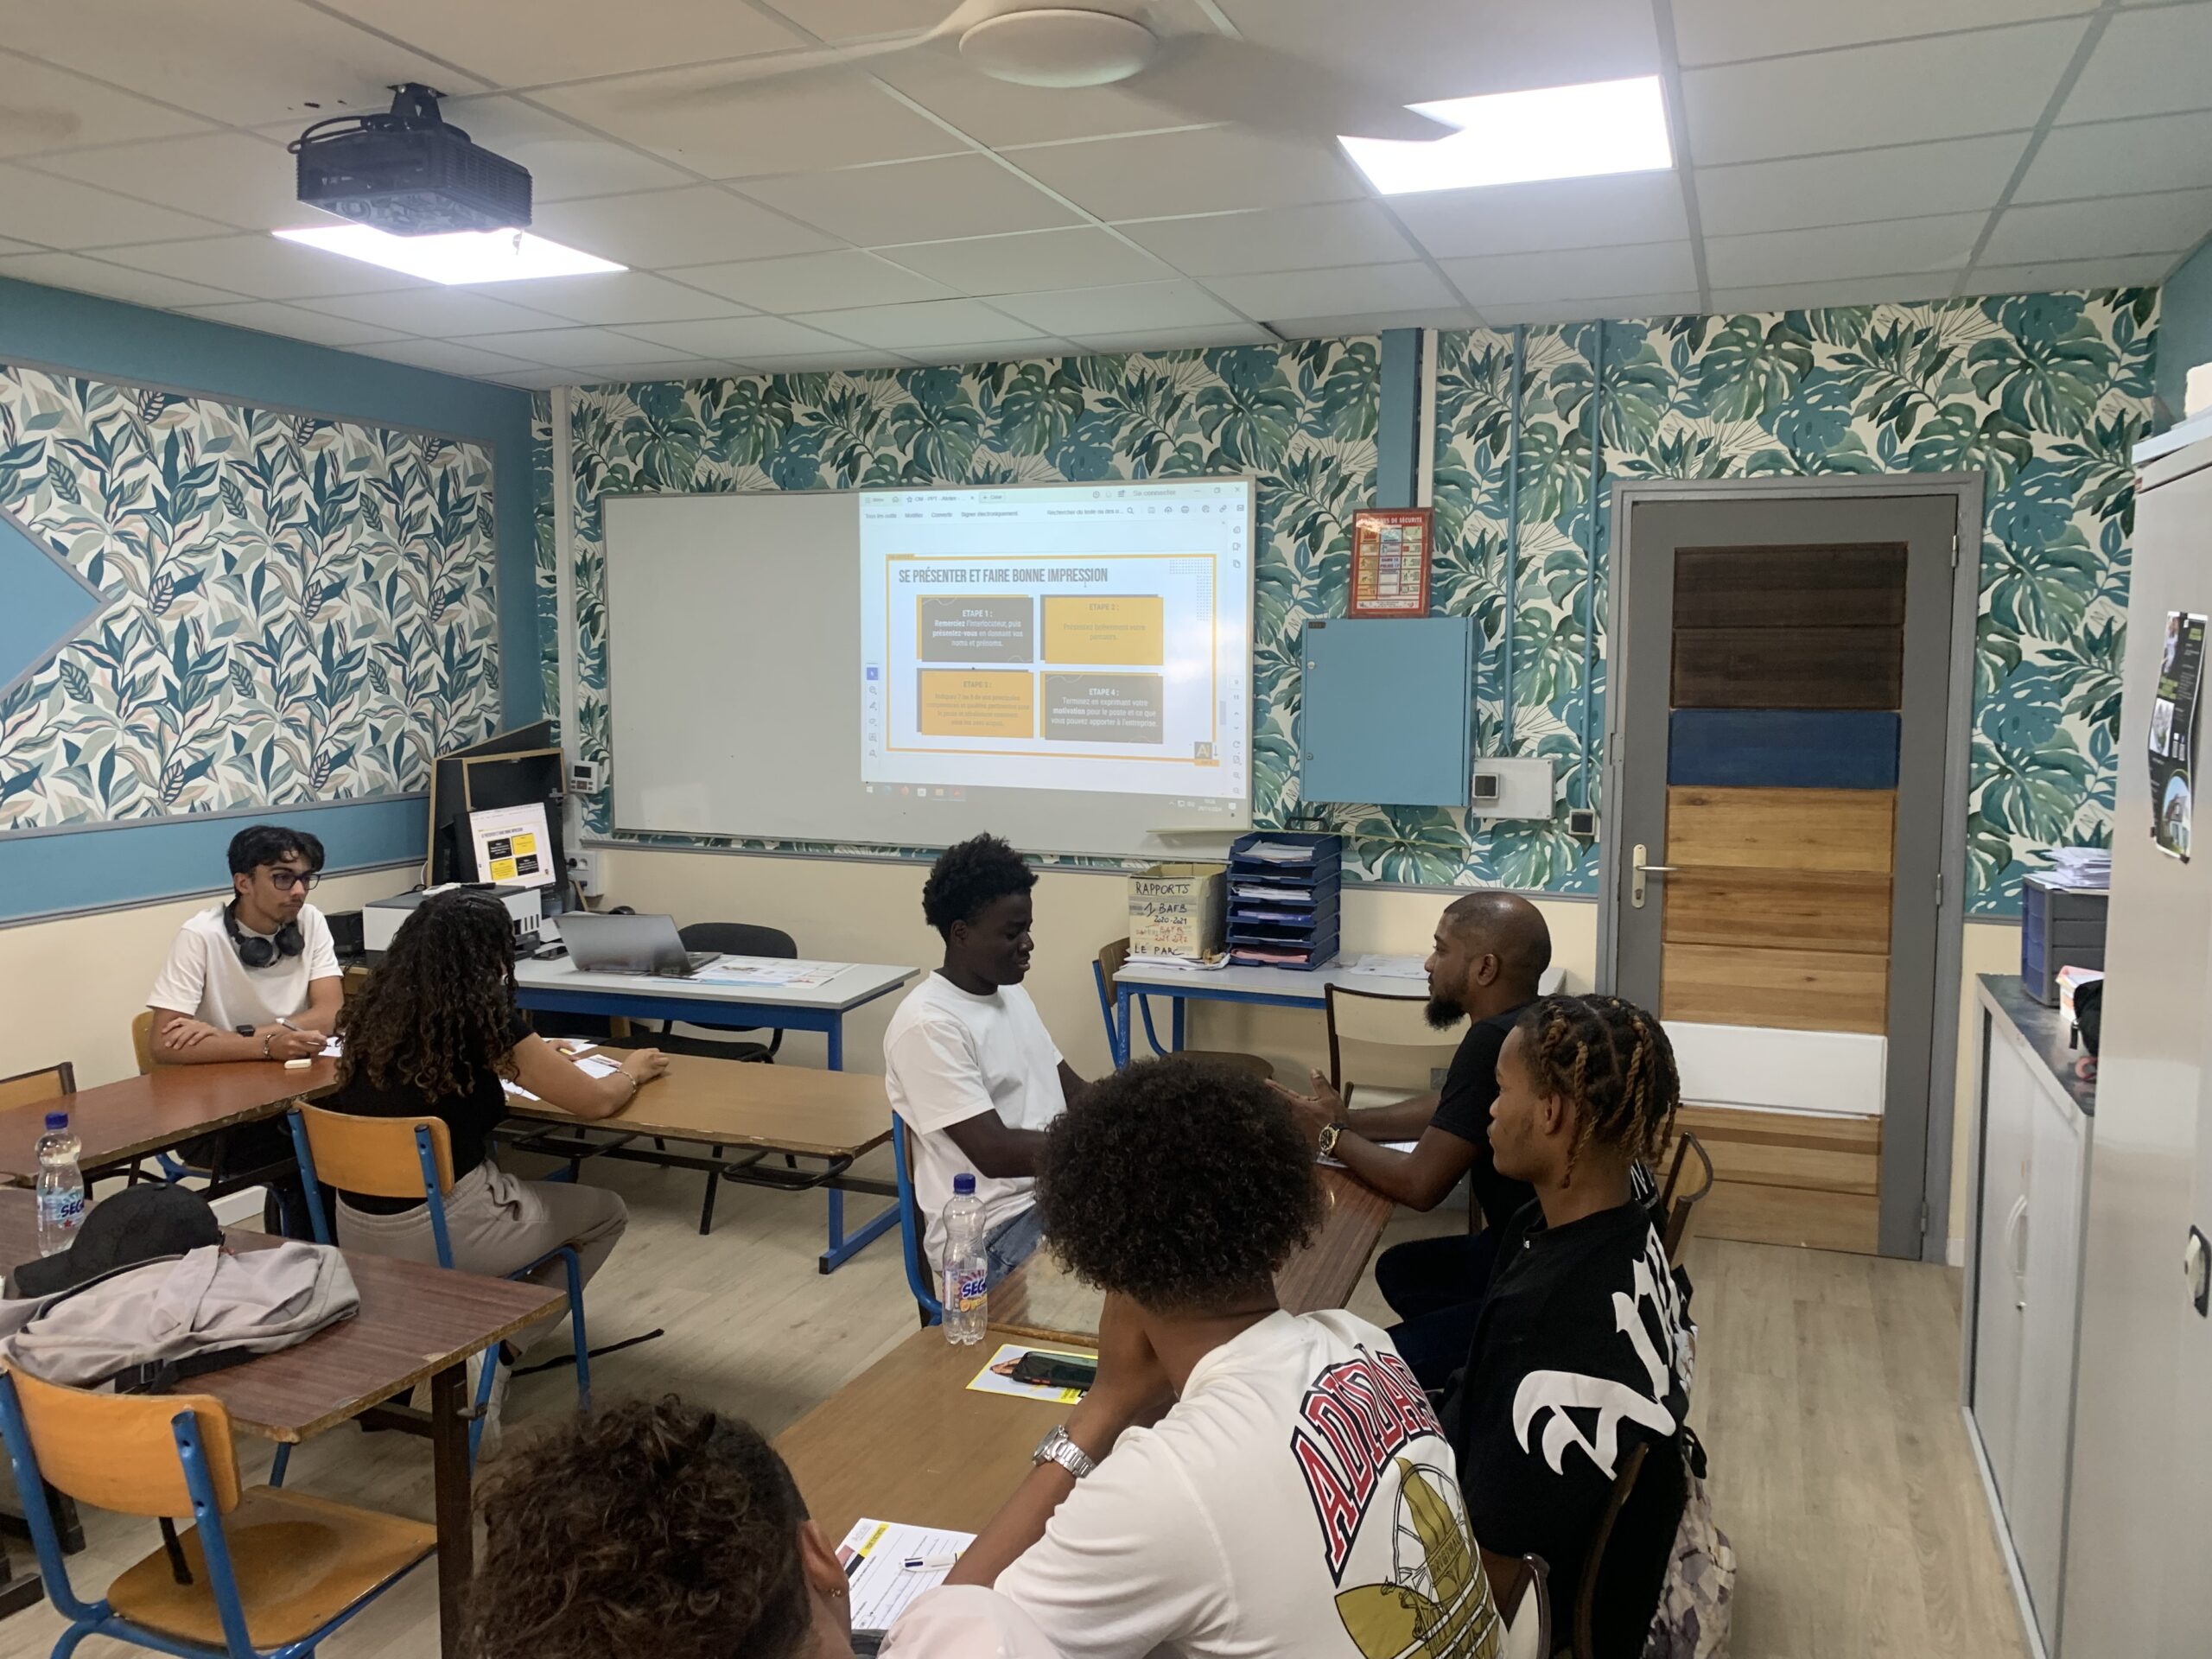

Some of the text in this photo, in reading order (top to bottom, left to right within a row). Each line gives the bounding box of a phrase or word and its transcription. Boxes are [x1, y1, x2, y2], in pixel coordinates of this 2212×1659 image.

[899, 566, 1109, 583] SE PRÉSENTER ET FAIRE BONNE IMPRESSION
[1008, 620, 1021, 629] puis
[932, 629, 977, 638] présentez-vous
[1100, 698, 1131, 707] exprimant
[1087, 708, 1102, 716] pour
[1109, 709, 1127, 717] poste
[1144, 709, 1156, 718] que
[1089, 718, 1116, 727] apporter
[1122, 719, 1158, 728] l'entreprise.
[1135, 881, 1191, 895] RAPPORTS
[1135, 944, 1185, 956] LE PARC
